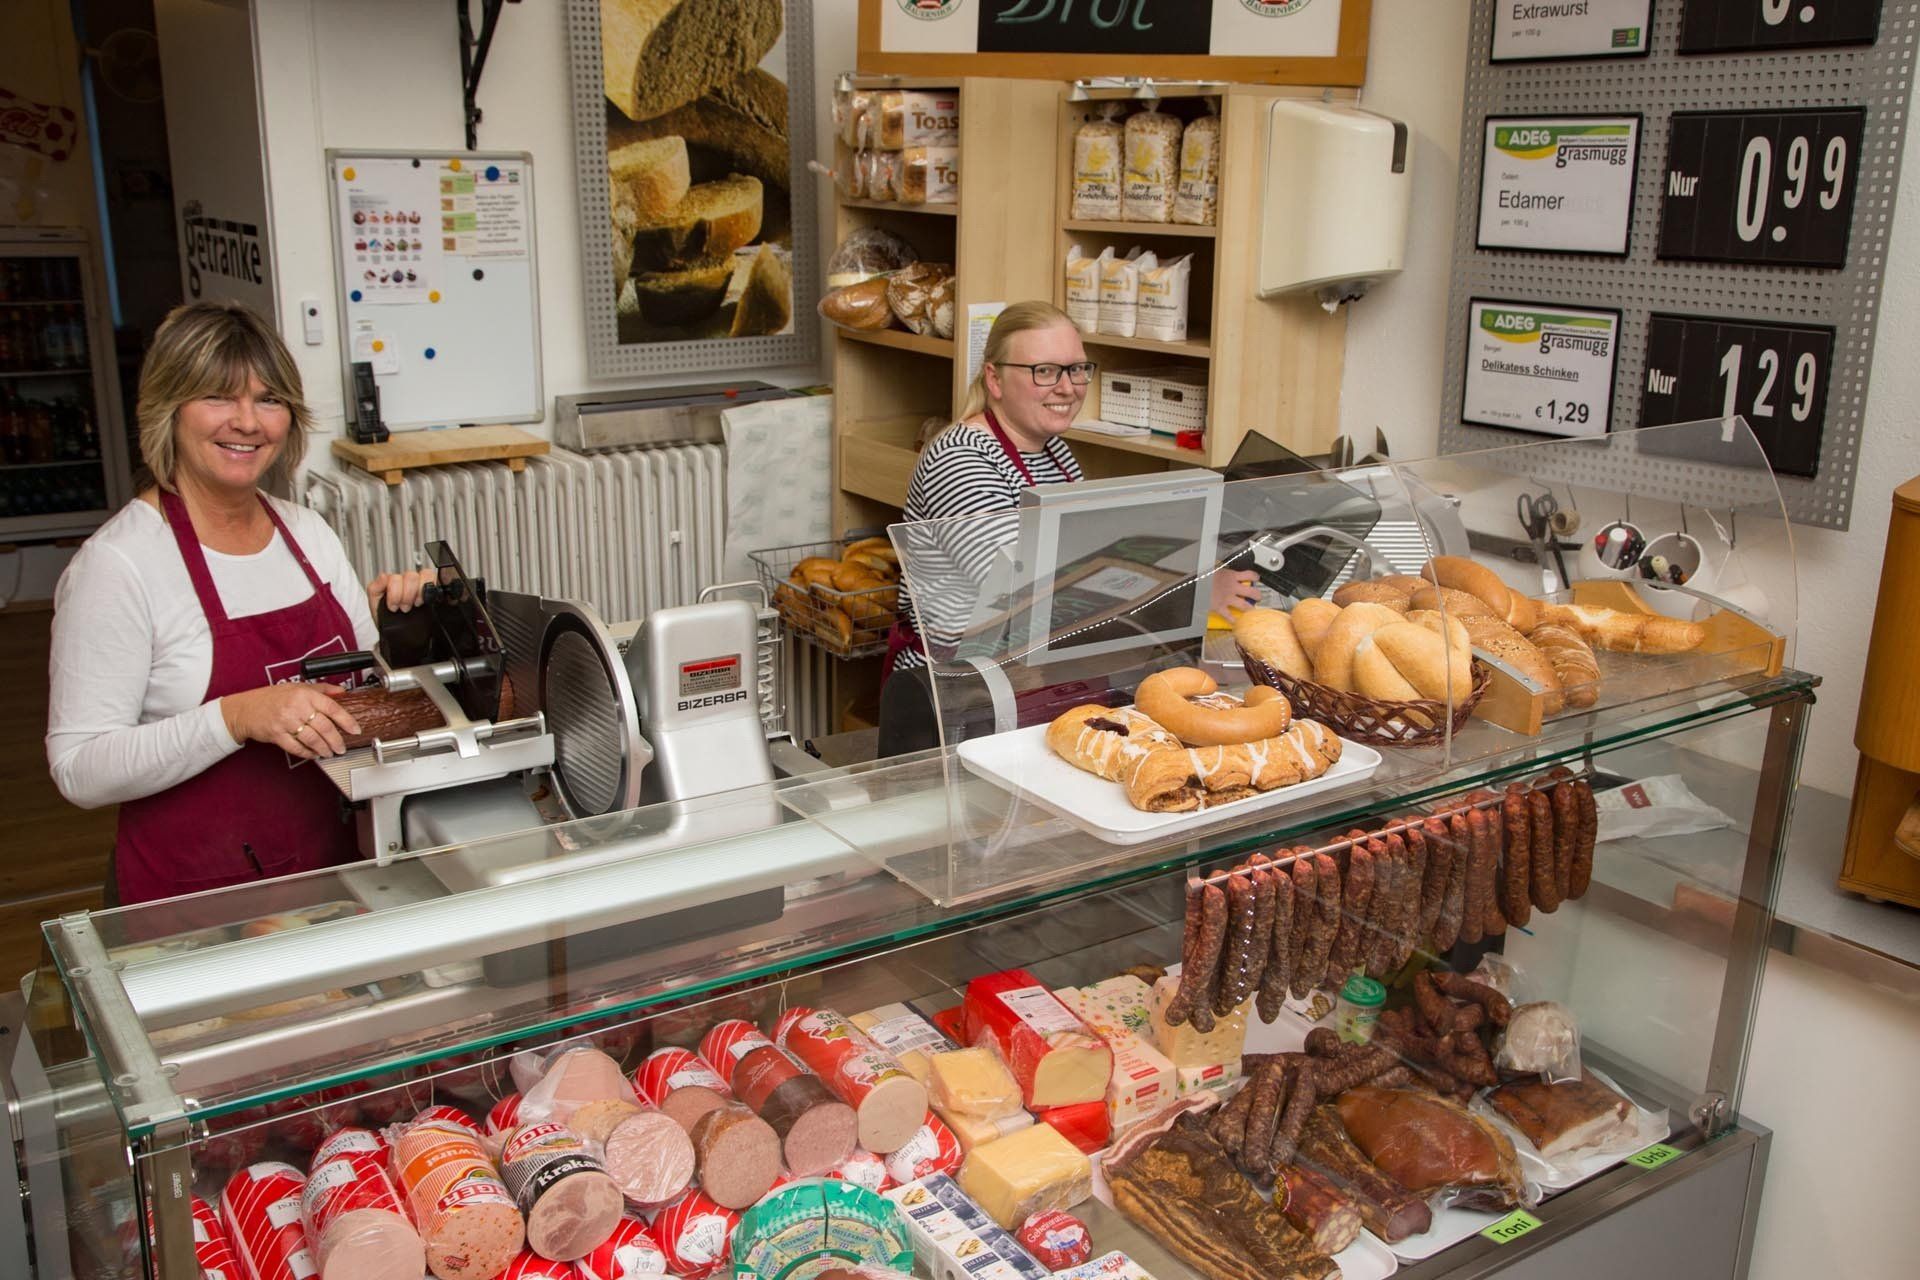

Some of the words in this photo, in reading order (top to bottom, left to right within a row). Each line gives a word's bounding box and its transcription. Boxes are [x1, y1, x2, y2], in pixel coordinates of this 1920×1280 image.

[1512, 1, 1589, 20] Extrawurst
[1509, 130, 1551, 145] ADEG
[1556, 145, 1628, 168] grasmugg
[1669, 171, 1698, 198] Nur
[1736, 136, 1847, 243] 0.99
[1499, 190, 1564, 210] Edamer
[1495, 315, 1536, 331] ADEG
[1540, 332, 1609, 357] grasmugg
[1482, 359, 1530, 375] Delikatess
[1533, 365, 1579, 380] Schinken
[1648, 368, 1677, 395] Nur
[1535, 406, 1543, 418] €
[1547, 400, 1589, 424] 1,29
[677, 690, 747, 711] BIZERBA
[1637, 1143, 1671, 1166] Urbi
[1492, 1218, 1531, 1239] Toni
